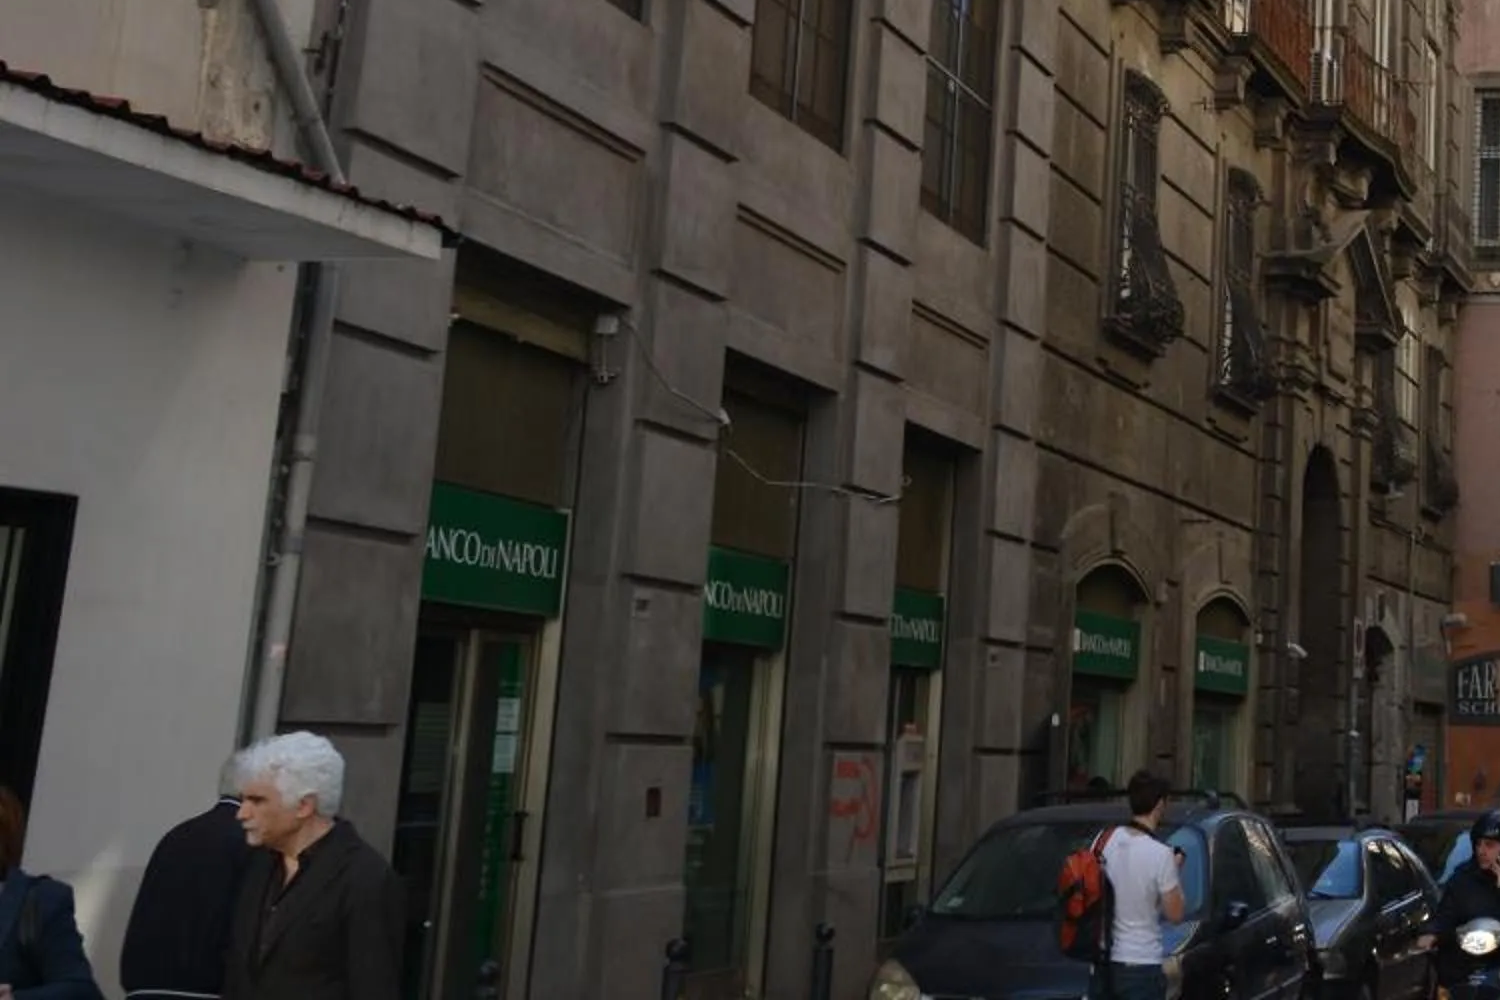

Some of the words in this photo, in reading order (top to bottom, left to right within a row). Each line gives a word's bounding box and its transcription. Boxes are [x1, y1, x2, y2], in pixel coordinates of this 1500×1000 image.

[426, 525, 482, 566] ANCO
[496, 538, 558, 578] NAPOLI
[703, 578, 732, 609] NCO
